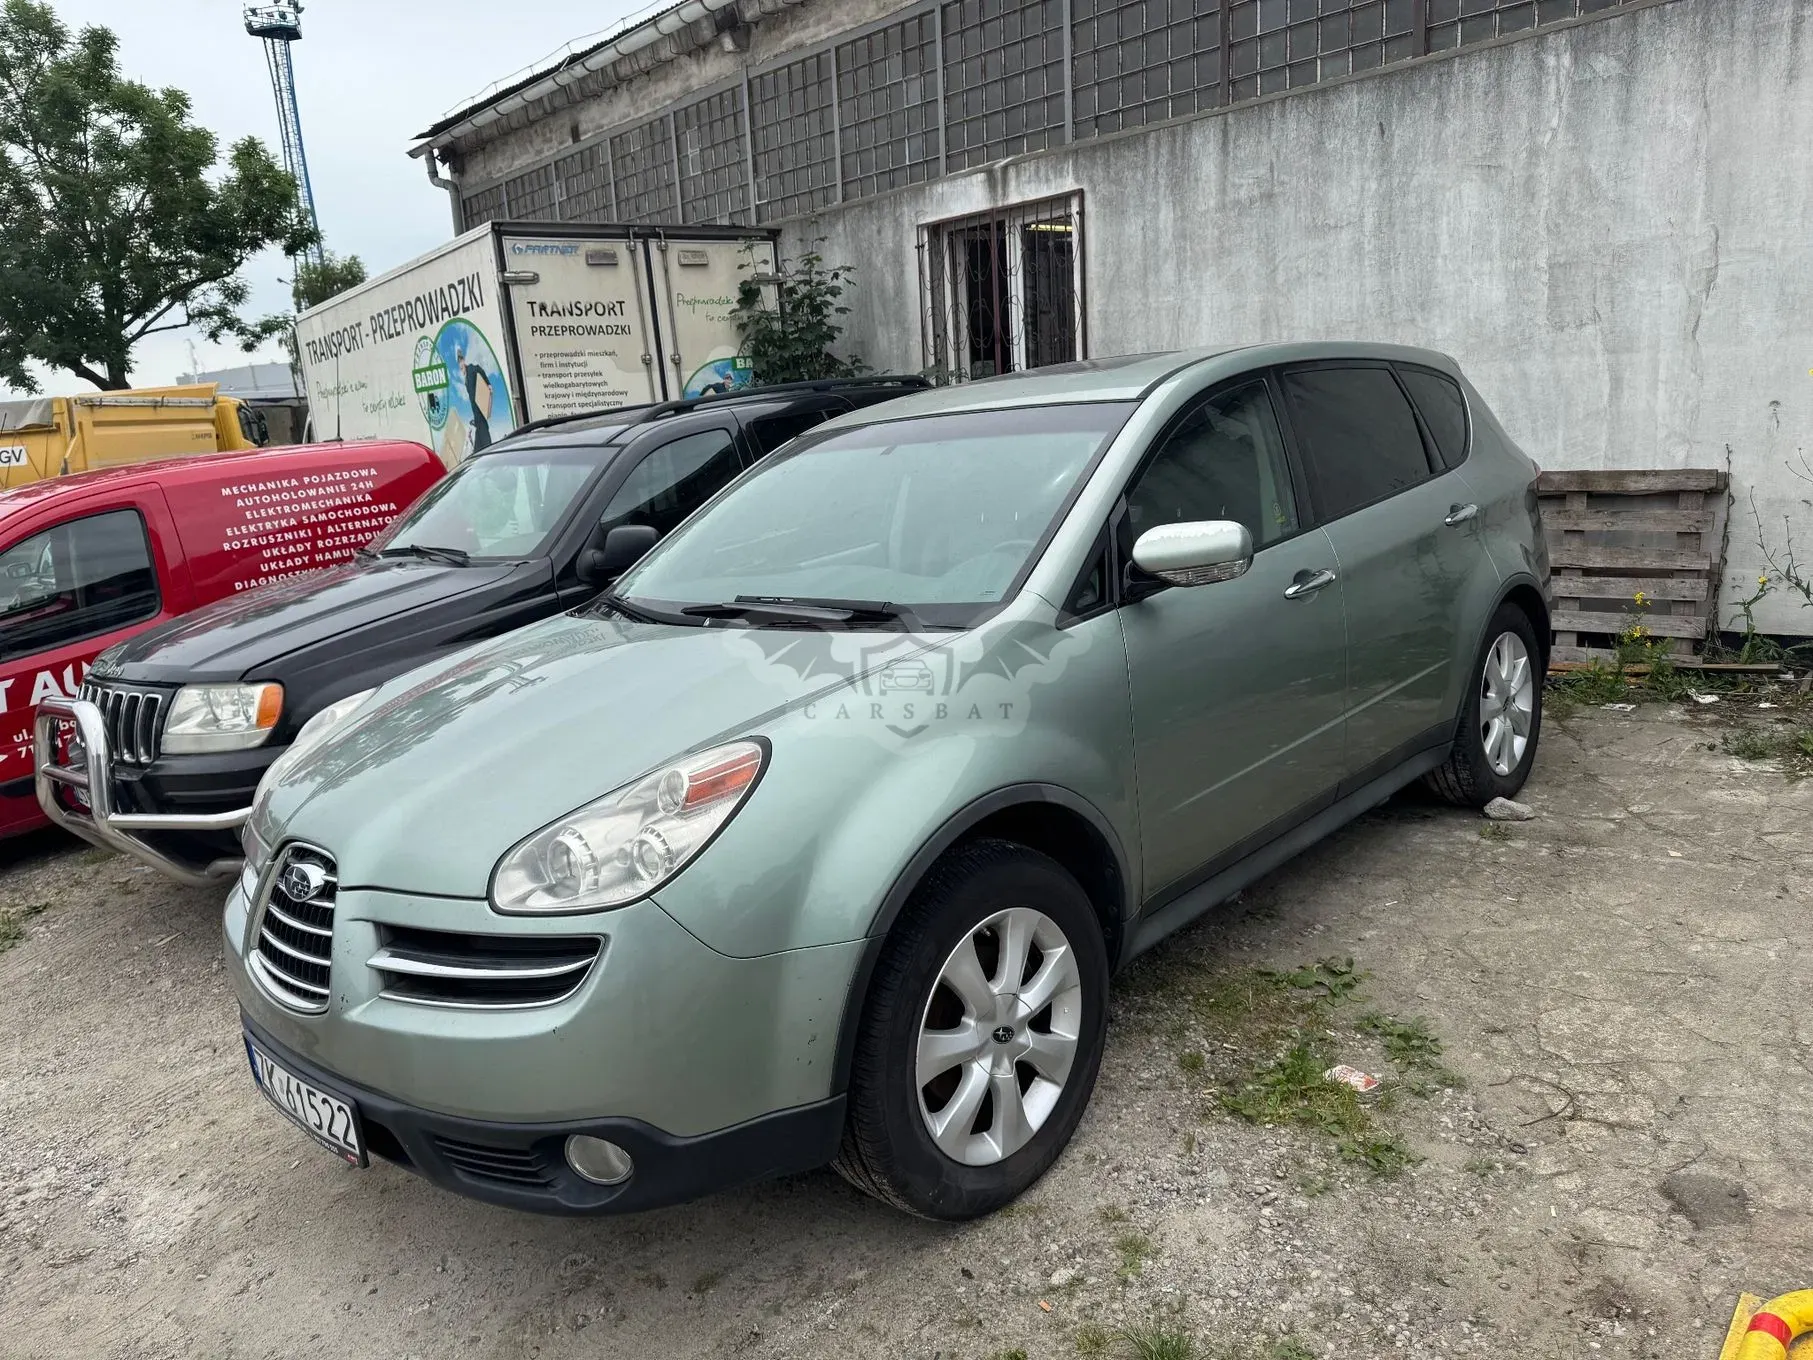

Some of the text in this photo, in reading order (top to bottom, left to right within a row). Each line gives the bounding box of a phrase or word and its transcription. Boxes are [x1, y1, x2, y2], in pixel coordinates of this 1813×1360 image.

[526, 300, 626, 317] TRANSPORT
[306, 322, 365, 366] TRANSPORT
[370, 272, 484, 344] PRZEPROWADZKI
[530, 324, 632, 337] PRZEPROWADZKI
[539, 350, 586, 359] przeprowadzki
[558, 360, 588, 369] instytucji
[414, 367, 446, 389] BARON
[542, 371, 573, 381] transport
[543, 380, 608, 390] wielkogabarytowych
[544, 392, 570, 400] krajowy
[546, 400, 623, 411] transport specjalistyczny
[221, 467, 378, 496] MECHANIKA POJAZDOWA
[236, 480, 374, 508] AUTOHOLOWANIE 24H
[244, 493, 373, 520] ELEKTROMECHANIKA
[226, 502, 397, 536] ELEKTRYKA SAMOCHODOWA
[222, 530, 312, 552] ROZRUSZNIKI
[317, 527, 322, 535] I
[262, 542, 312, 558] UKŁADY
[259, 555, 310, 572] UKŁADY
[12, 728, 34, 743] ul.
[285, 1075, 357, 1151] 61522
